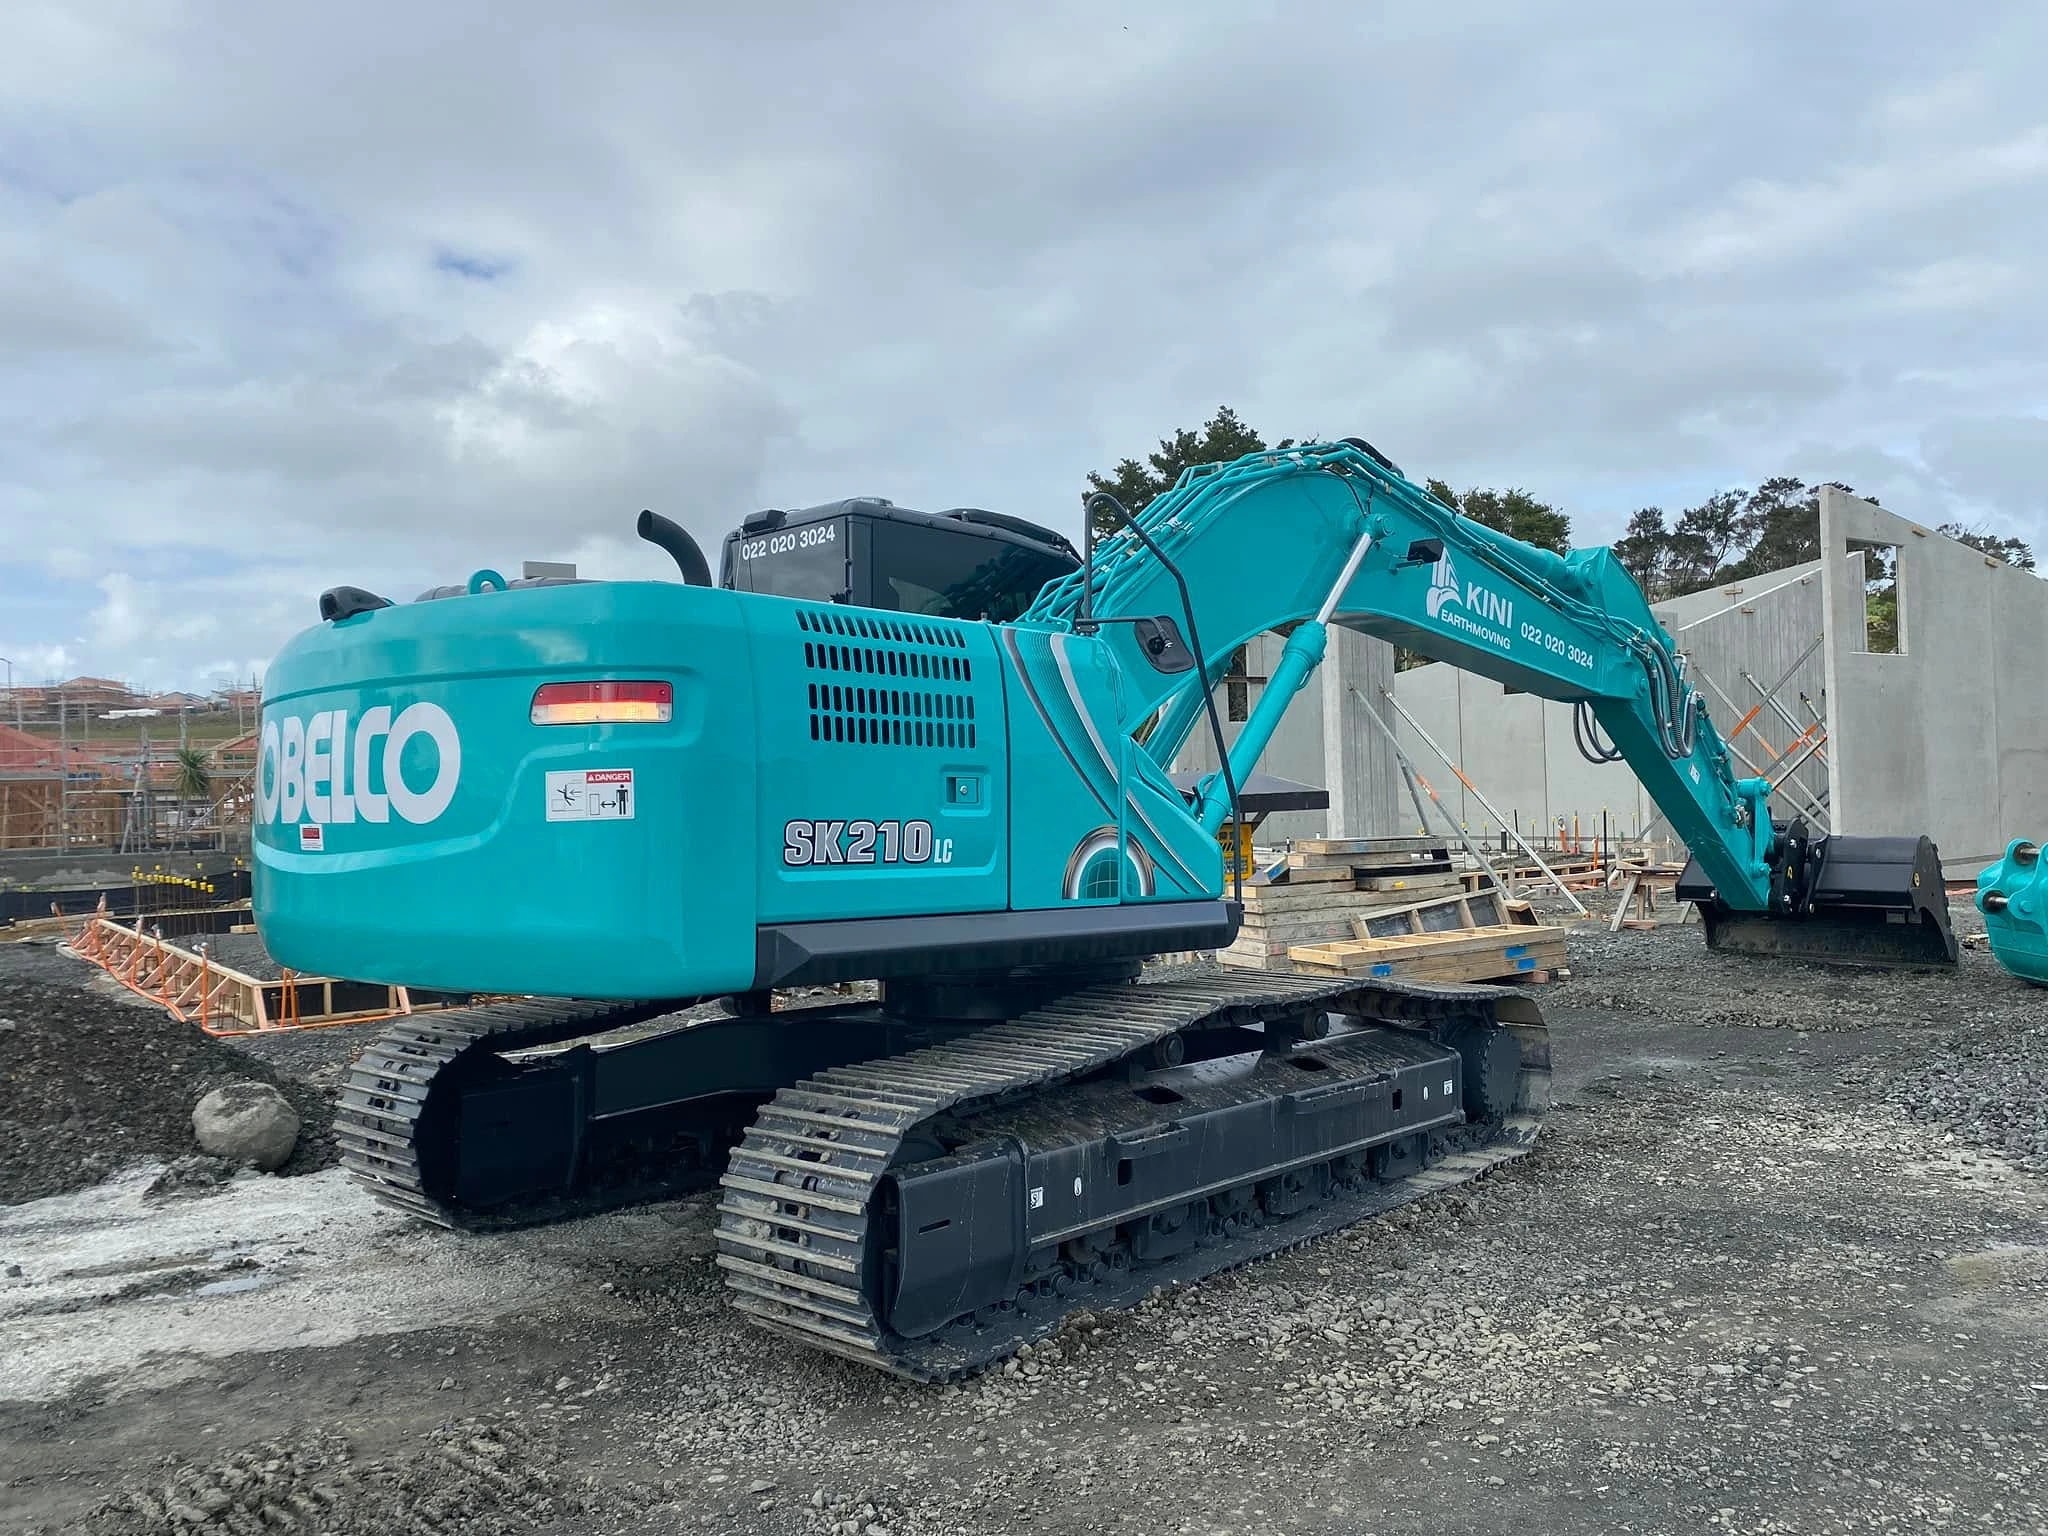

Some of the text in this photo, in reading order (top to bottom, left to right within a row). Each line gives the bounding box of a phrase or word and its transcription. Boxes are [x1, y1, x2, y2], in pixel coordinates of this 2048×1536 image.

[742, 524, 836, 561] 022 020 3024
[1466, 581, 1513, 629] KINI
[1441, 609, 1511, 650] EARTHMOVING
[1520, 621, 1594, 671] 022 020 3024
[255, 702, 461, 824] OBELCO
[595, 772, 630, 782] DANGER
[784, 820, 953, 866] SK210 LC
